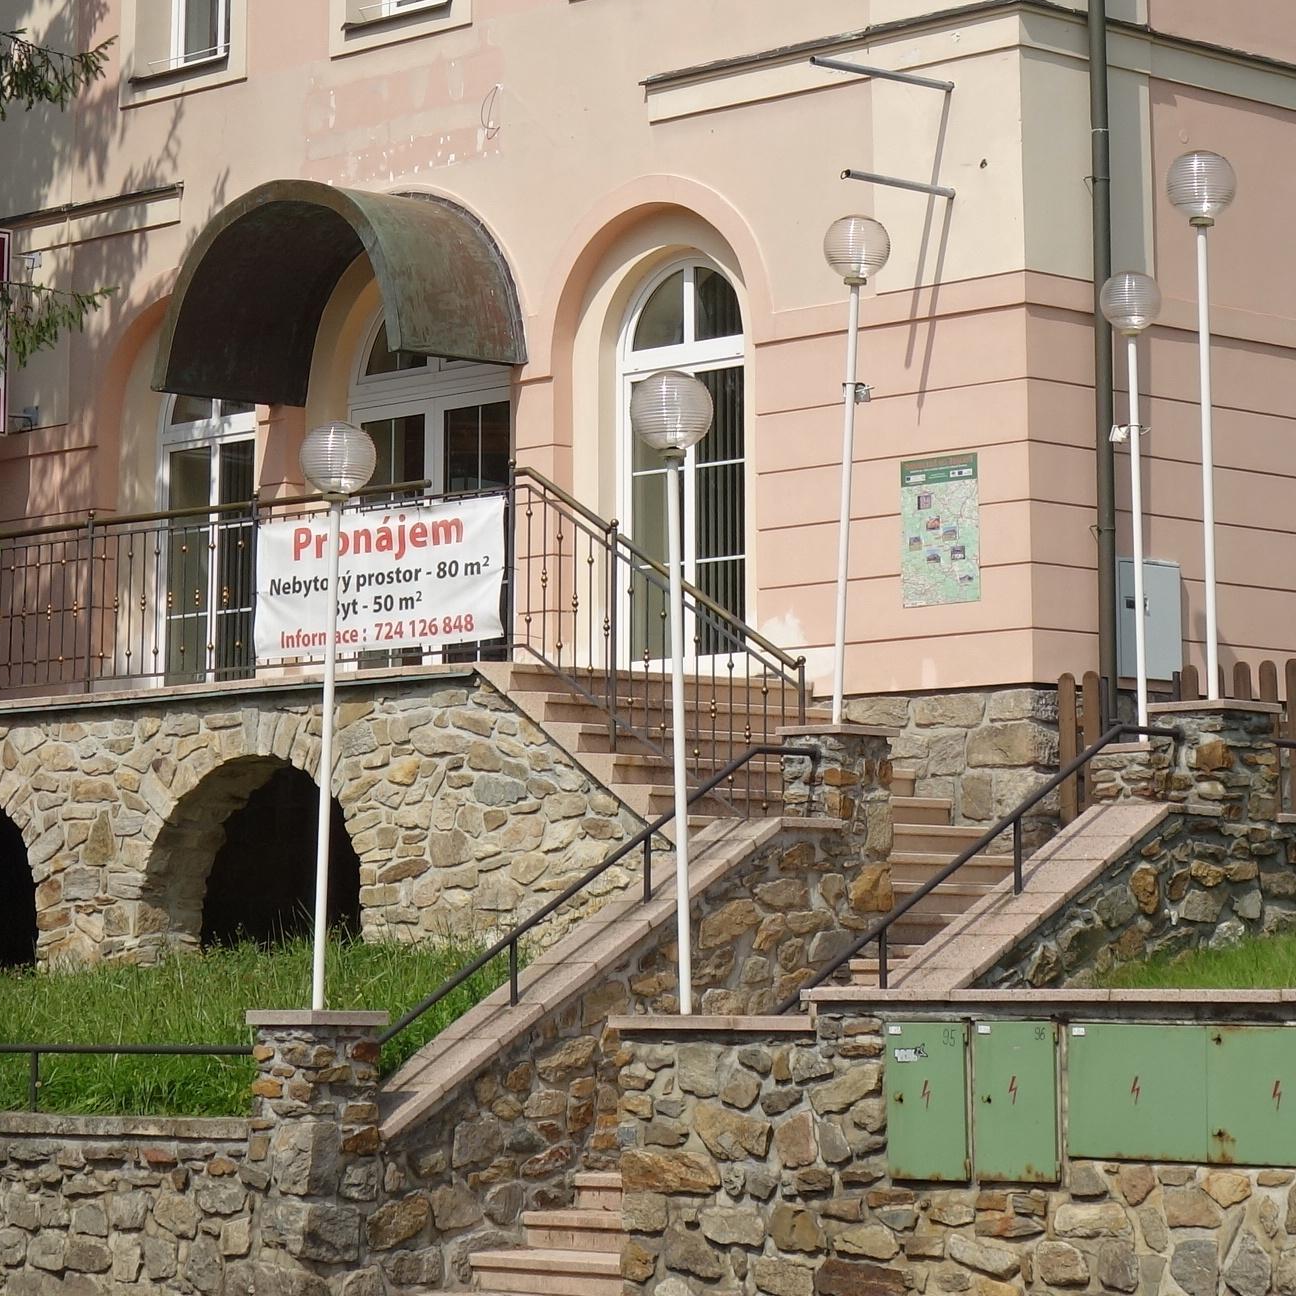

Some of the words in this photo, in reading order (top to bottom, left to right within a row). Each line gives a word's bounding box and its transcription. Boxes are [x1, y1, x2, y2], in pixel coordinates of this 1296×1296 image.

[293, 514, 464, 561] Pronájem
[269, 569, 352, 598] Nebytoý
[356, 567, 422, 592] prostor
[436, 560, 459, 579] 80
[373, 594, 394, 613] 50
[374, 620, 404, 641] 724
[409, 617, 439, 638] 126
[442, 613, 474, 635] 848
[942, 1028, 956, 1047] 95
[1034, 1026, 1046, 1041] 96
